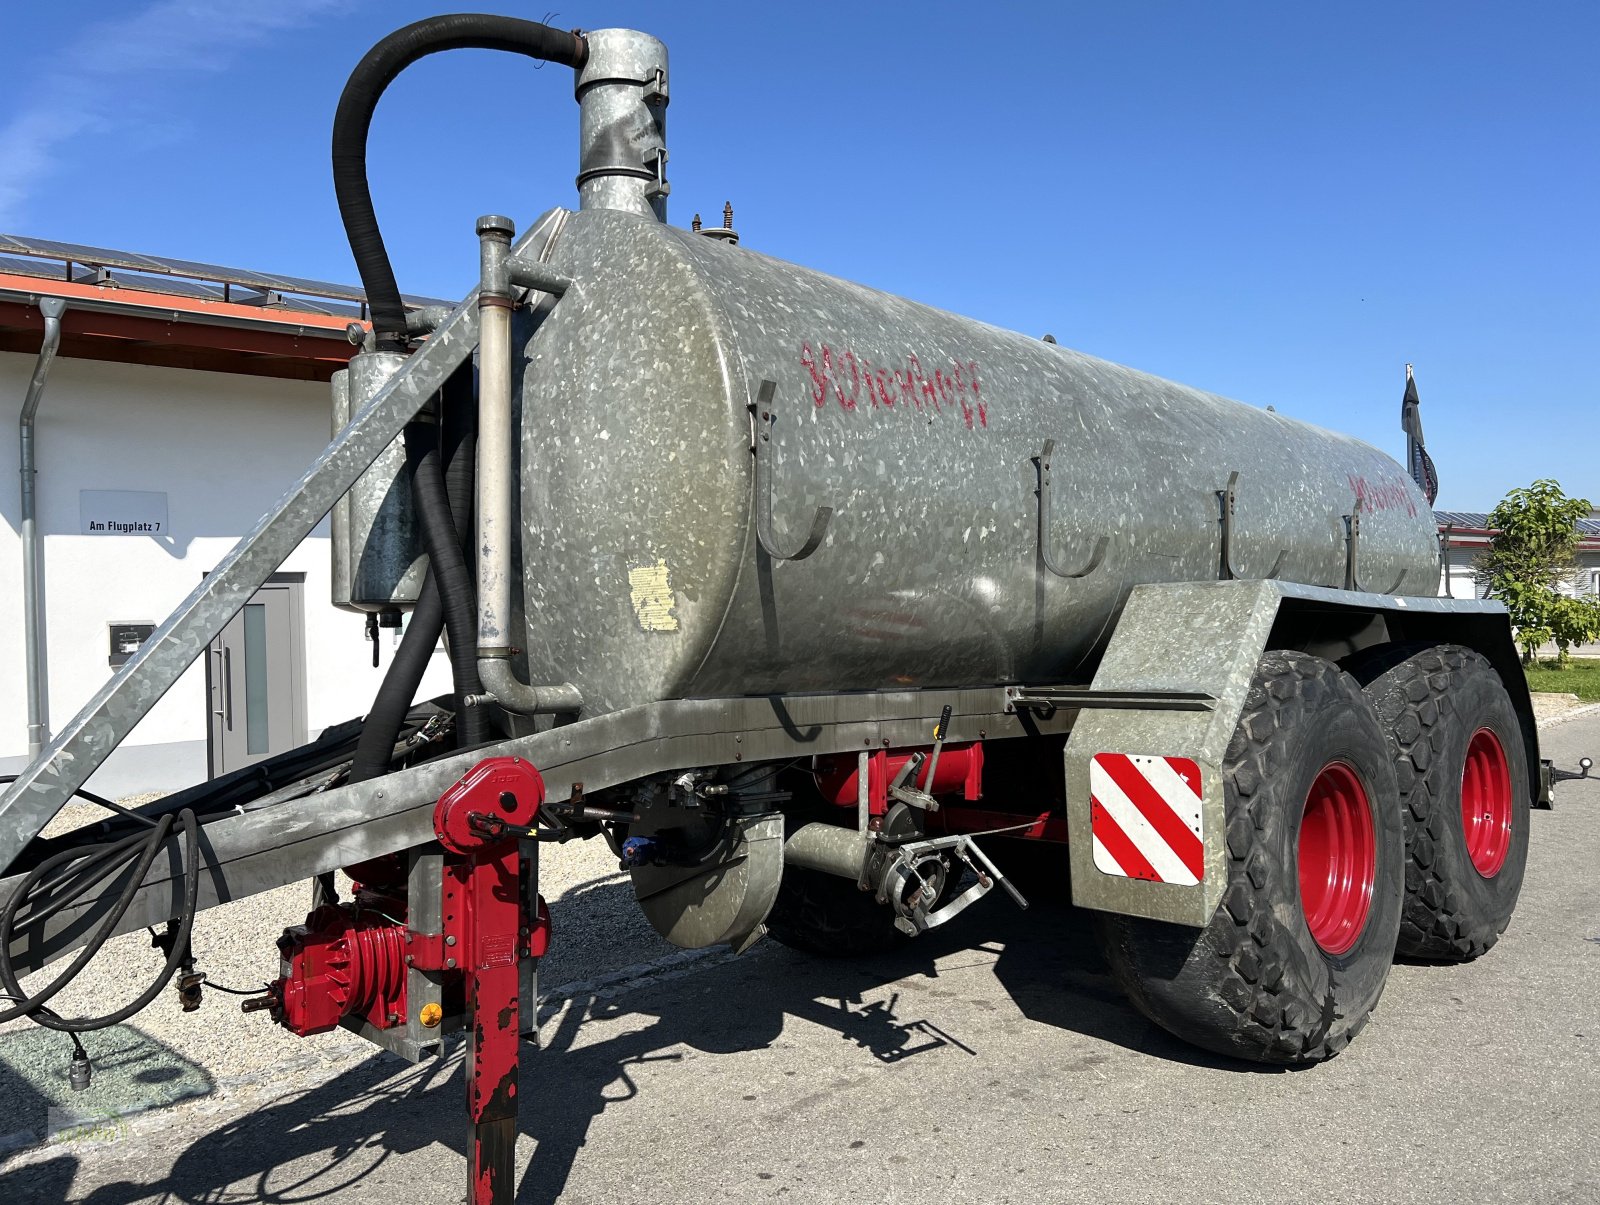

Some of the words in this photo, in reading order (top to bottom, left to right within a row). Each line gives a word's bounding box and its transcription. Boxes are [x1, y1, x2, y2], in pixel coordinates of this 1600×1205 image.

[89, 521, 105, 531] Am
[108, 521, 152, 533] Flugplatz
[155, 522, 161, 531] 7
